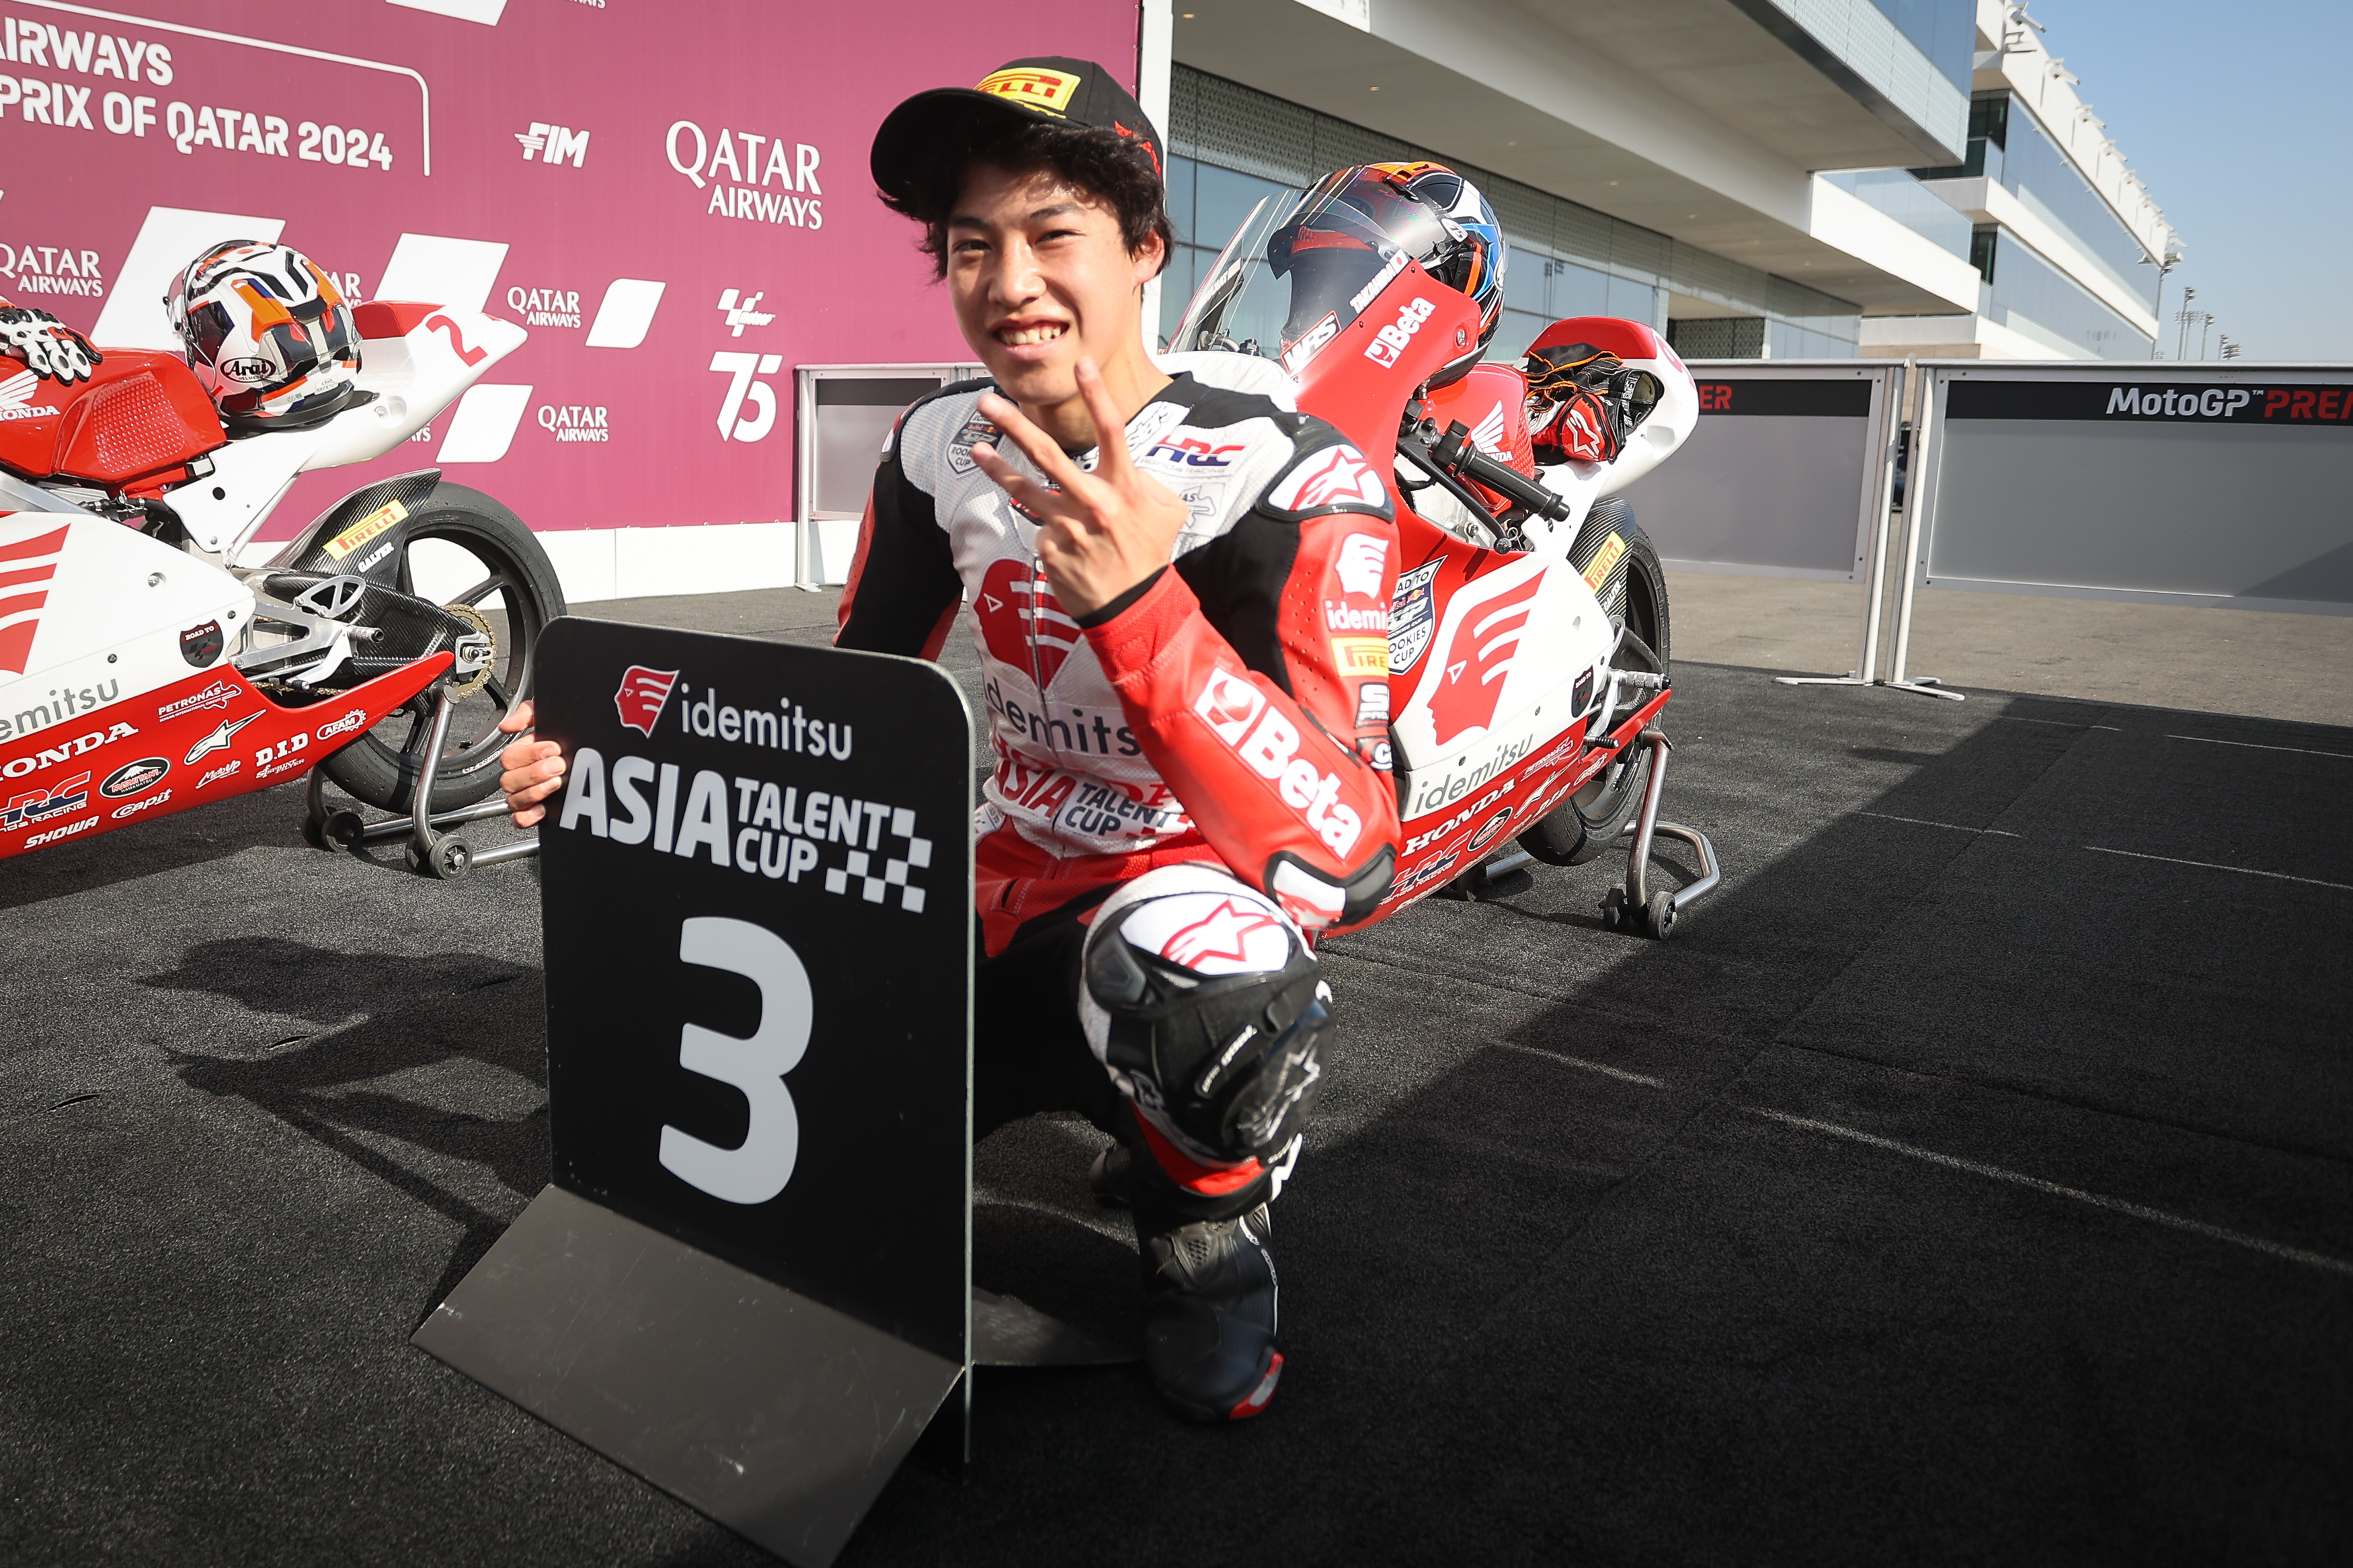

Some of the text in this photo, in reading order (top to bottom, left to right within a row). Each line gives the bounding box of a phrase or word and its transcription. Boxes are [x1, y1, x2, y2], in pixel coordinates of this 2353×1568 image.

[0, 16, 173, 87] IRWAYS
[0, 74, 394, 171] PRIX OF QATAR 2024
[514, 121, 590, 168] FIM
[665, 120, 822, 196] QATAR
[707, 183, 823, 230] AIRWAYS
[0, 243, 102, 279] QATAR
[17, 278, 104, 297] AIRWAYS
[506, 286, 582, 315] QATAR
[1349, 263, 1397, 314] TAKAHIRA
[526, 311, 582, 329] AIRWAYS
[1383, 296, 1437, 350] Beta
[425, 315, 489, 368] 2
[1283, 313, 1337, 374] WRS
[225, 360, 268, 377] Arai
[708, 350, 784, 443] 75
[537, 405, 608, 433] QATAR
[555, 427, 609, 443] AIRWAYS
[955, 456, 971, 466] CUP
[1140, 458, 1183, 472] Honda
[1146, 434, 1247, 466] HRC
[335, 507, 397, 551] PIRELLI
[358, 541, 395, 573] GALFER
[1584, 540, 1620, 591] PIRELLI
[1415, 571, 1430, 585] TO
[1603, 579, 1622, 612] GALFER
[185, 625, 215, 641] ROAD TO
[1393, 647, 1415, 665] CUP
[1574, 674, 1587, 689] ROAD
[157, 686, 222, 716] PETRONAS
[175, 704, 206, 719] INTERNATIONAL
[204, 697, 223, 708] CIRCUIT
[323, 716, 357, 737] AFAM
[680, 682, 854, 761] idemitsu
[0, 721, 139, 782] ONDA
[255, 733, 309, 767] D.I.D
[111, 768, 159, 794] KUSHITANI
[120, 778, 154, 794] HAMAMATSU
[1238, 704, 1362, 860] Beta
[1414, 733, 1533, 813] idemitsu
[31, 800, 88, 823] RACING
[559, 747, 731, 868] ASIA
[734, 776, 891, 852] TALENT
[1064, 807, 1121, 837] CUP
[1400, 778, 1516, 858] HONDA
[24, 815, 101, 850] SHOWA
[735, 827, 820, 884] CUP
[1415, 860, 1455, 888] RACING
[658, 916, 814, 1205] 3
